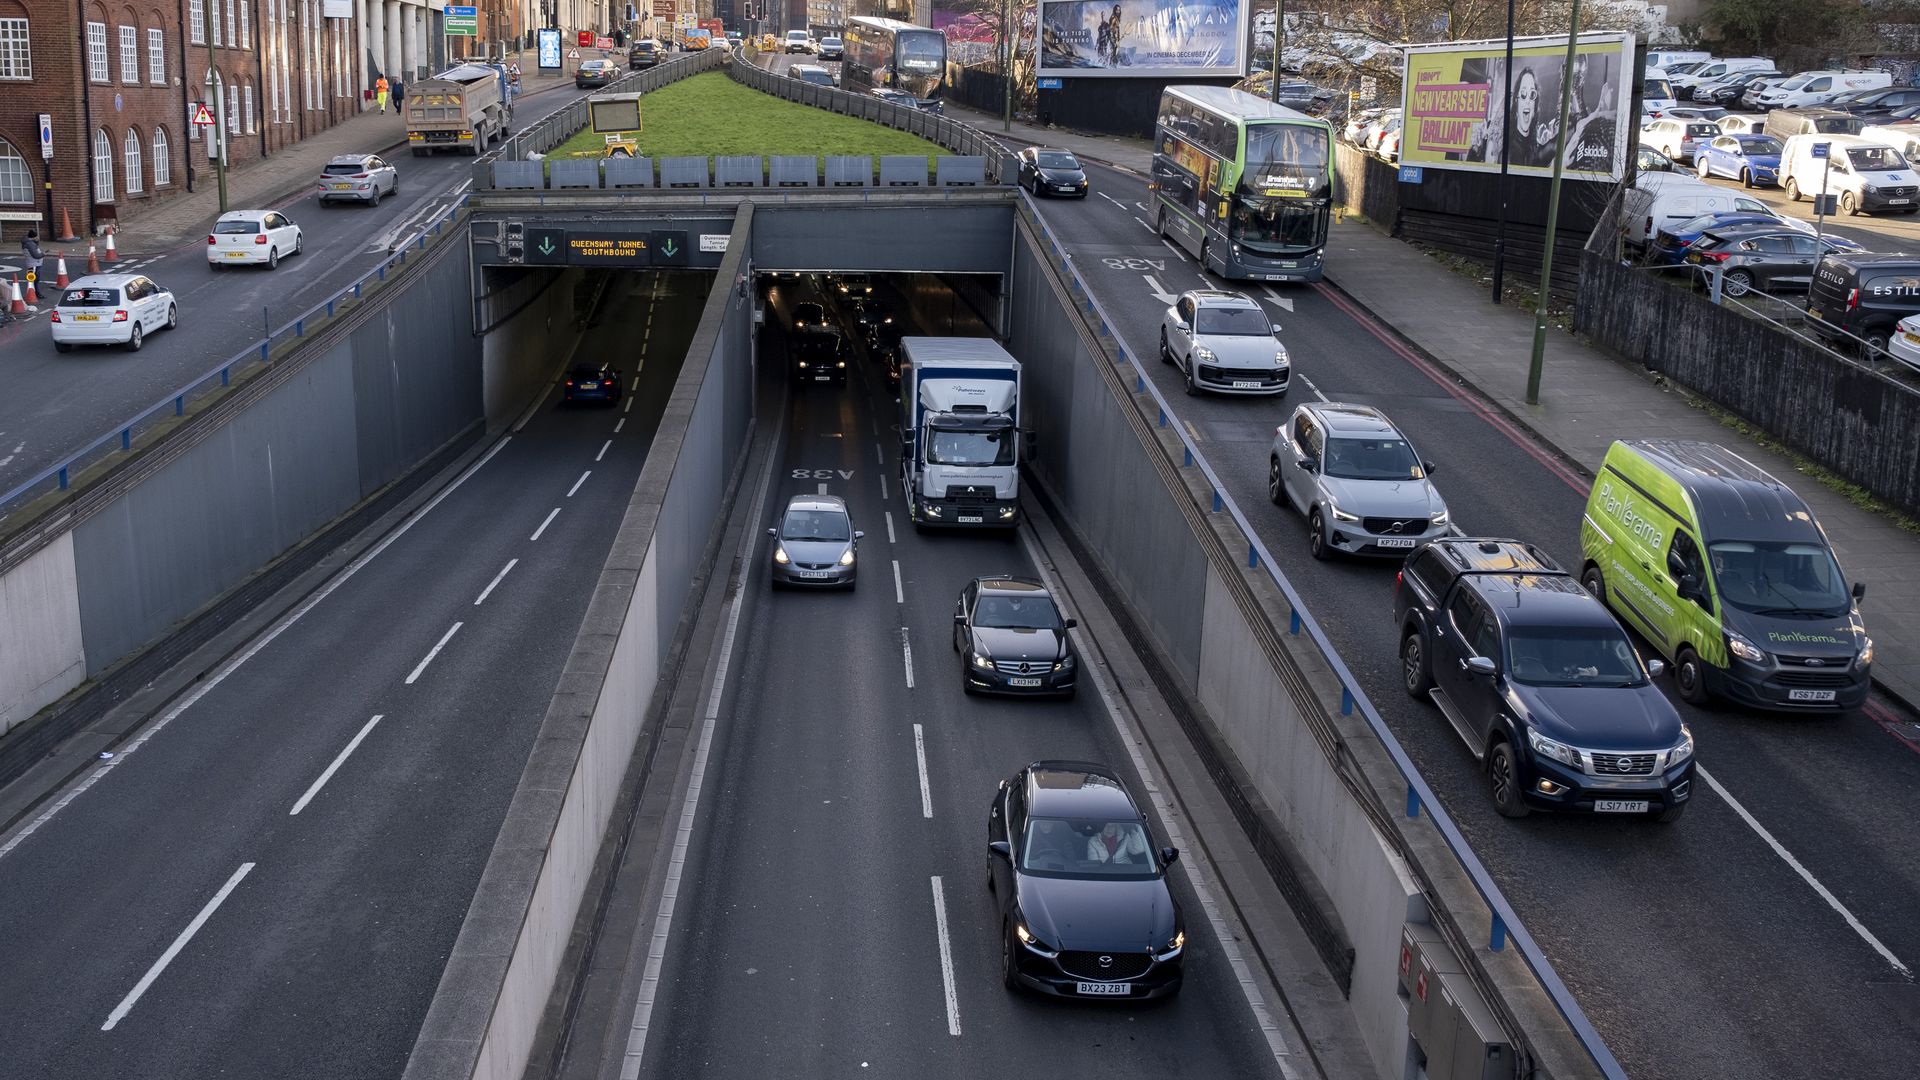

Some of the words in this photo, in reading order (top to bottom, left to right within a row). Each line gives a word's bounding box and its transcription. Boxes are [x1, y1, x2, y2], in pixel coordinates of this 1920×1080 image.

[1176, 50, 1206, 58] DECEMBER
[1042, 78, 1058, 88] global
[1414, 90, 1435, 112] NEW
[1434, 89, 1466, 112] YEAR'S
[1466, 89, 1487, 112] EVE
[1422, 119, 1471, 145] BRILLIANT
[1583, 145, 1608, 158] skiddle
[1403, 167, 1418, 181] global
[1267, 175, 1298, 184] Birmingham
[1308, 176, 1315, 189] 9
[570, 240, 614, 248] QUEENSWAY
[618, 240, 647, 248] TUNNEL
[582, 248, 636, 257] SOUTHBOUND
[1102, 258, 1165, 271] A38
[1819, 269, 1844, 285] ESTILO
[792, 469, 855, 480] A38
[1012, 677, 1027, 685] LX13
[1599, 802, 1622, 811] LS17
[1625, 802, 1643, 811] YRT
[1081, 983, 1107, 993] BX23
[1108, 984, 1127, 993] ZBT
